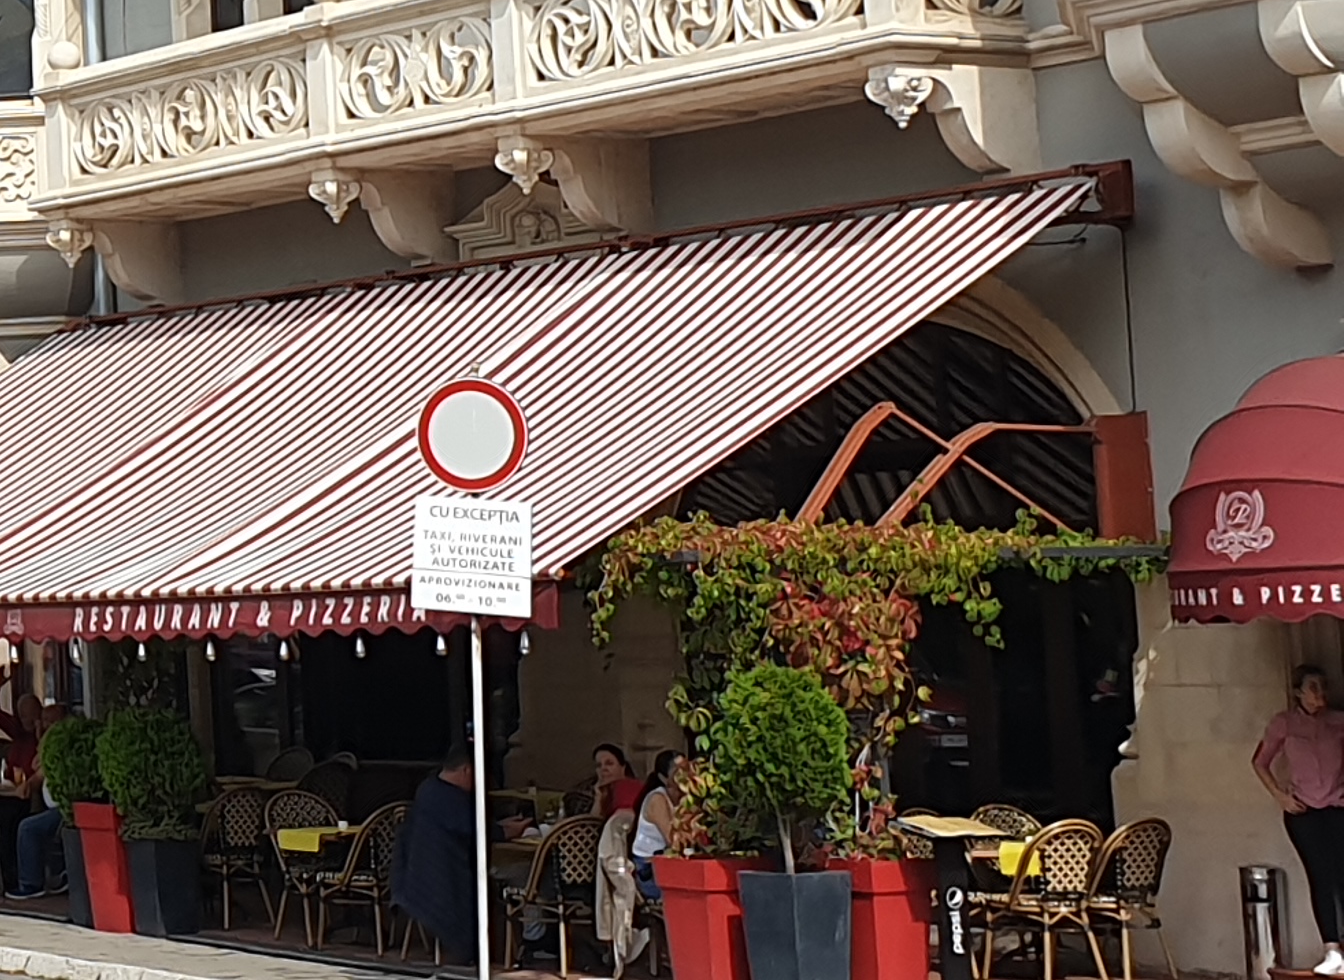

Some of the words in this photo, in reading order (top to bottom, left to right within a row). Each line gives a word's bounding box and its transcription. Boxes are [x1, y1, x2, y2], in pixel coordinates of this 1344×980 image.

[429, 505, 450, 518] CU
[423, 529, 456, 543] TAXI,
[459, 533, 523, 547] RIVERANI
[448, 544, 515, 560] VEHICULE
[431, 556, 516, 573] AUTORIZATE
[418, 575, 521, 592] APROVIZIONARE
[1232, 587, 1245, 606] &
[73, 601, 241, 633] RESTAURANT
[255, 600, 271, 628] &
[948, 910, 965, 955] pepsi
